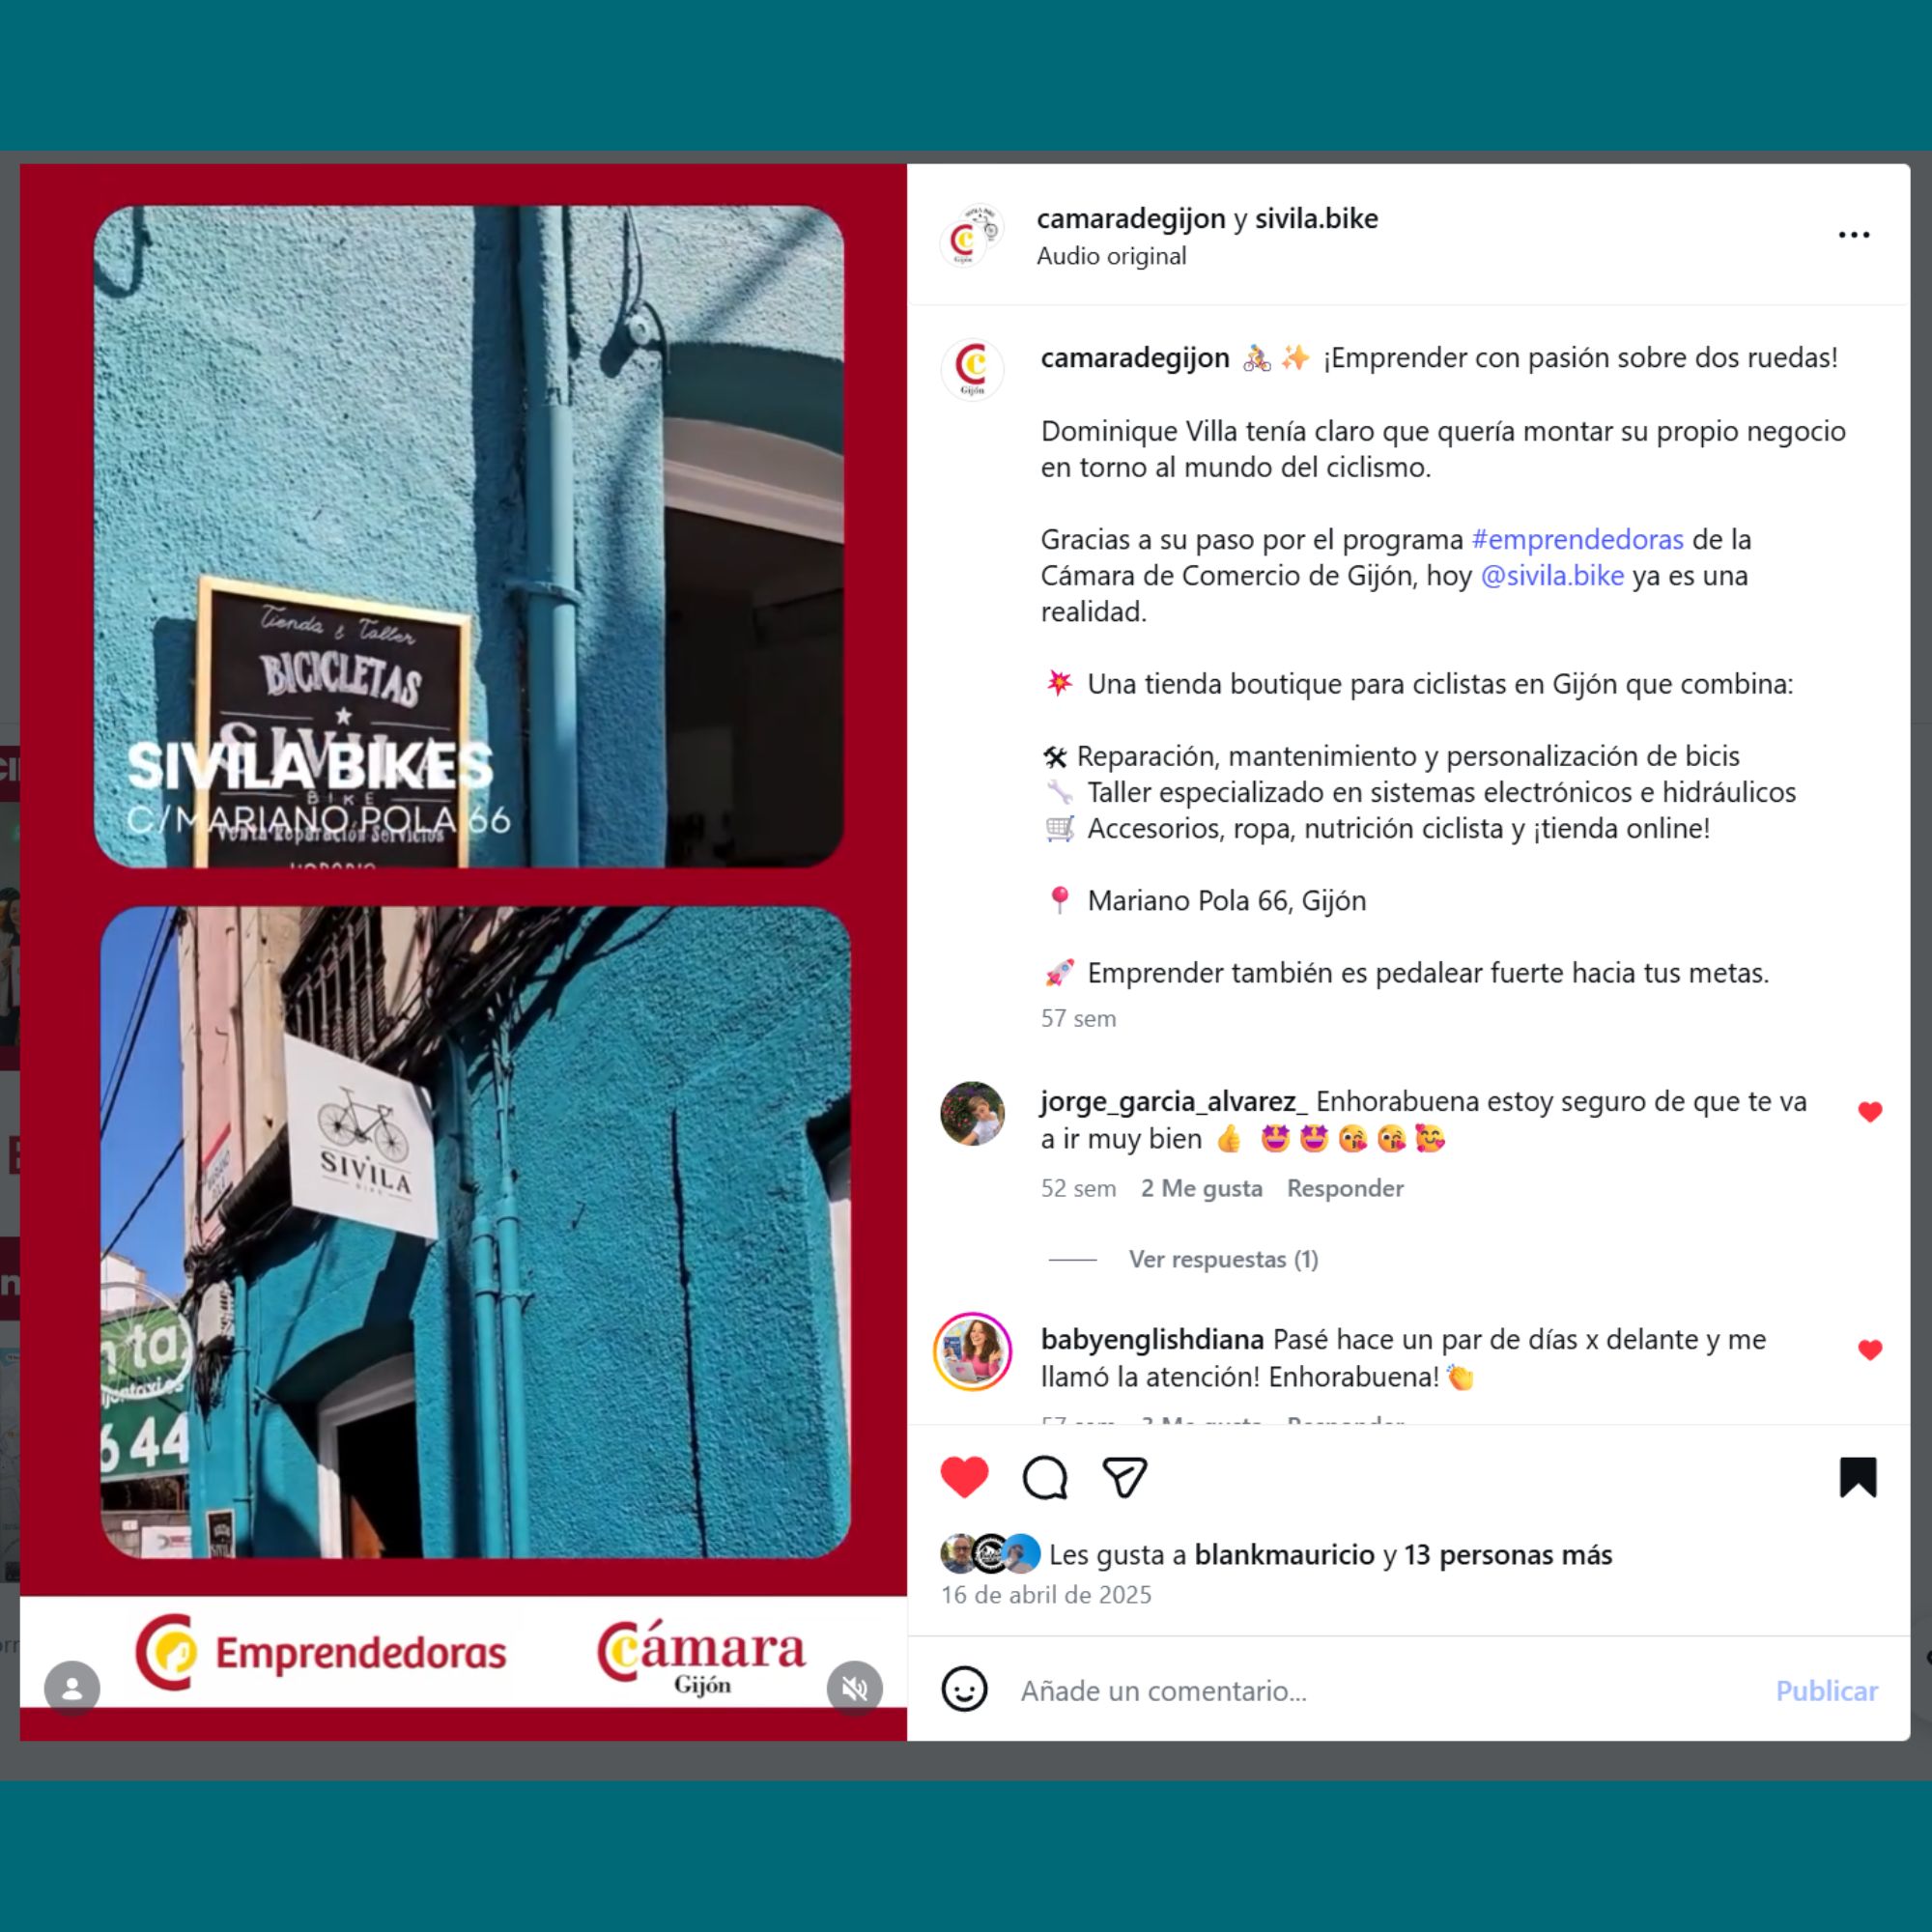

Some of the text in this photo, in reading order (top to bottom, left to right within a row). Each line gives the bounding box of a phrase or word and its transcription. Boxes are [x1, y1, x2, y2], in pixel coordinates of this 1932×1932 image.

[1037, 206, 1378, 236] camaradegijon y sivila.bike
[1041, 345, 1230, 375] camaradegijon
[1325, 345, 1837, 375] ¡Emprender con pasión sobre dos ruedas!
[1043, 419, 1846, 448] Dominique Villa tenía claro que quería montar su propio negocio
[1041, 527, 1751, 556] Gracias a su paso por el programa #emprendedoras de la
[1041, 563, 1747, 592] Cámara de Comercio de Gijón, hoy @sivila.bike ya es una
[260, 604, 325, 635] Tienda
[358, 617, 416, 646] Taller
[259, 650, 423, 708] BICICLETAS
[1089, 671, 1793, 700] Una tienda boutique para ciclistas en Gijón que combina:
[1079, 744, 1740, 773] Reparación, mantenimiento y personalización de bicis
[1088, 781, 1796, 810] Taller especializado en sistemas electrónicos e hidráulicos
[1088, 816, 1709, 845] Accesorios, ropa, nutrición ciclista y ¡tienda online!
[1090, 889, 1366, 918] Mariano Pola 66, Gijón
[1090, 960, 1769, 989] Emprender también es pedalear fuerte hacia tus metas.
[1038, 1089, 1806, 1119] jorge_garcia_alvarez_ Enhorabuena estoy seguro de que te va
[321, 1151, 412, 1194] SIVILA
[1042, 1178, 1405, 1203] 52 sem 2 Me gusta Responder
[1042, 1327, 1767, 1356] babyenglishdiana Pasé hace un par de días x delante y me
[1042, 1365, 1438, 1387] llamó la atención! Enhorabuena!
[1051, 1543, 1612, 1572] Les gusta a blankmauricio y 13 personas más
[943, 1584, 1151, 1604] 16 de abril de 2025
[1021, 1679, 1306, 1701] Añade un comentario...
